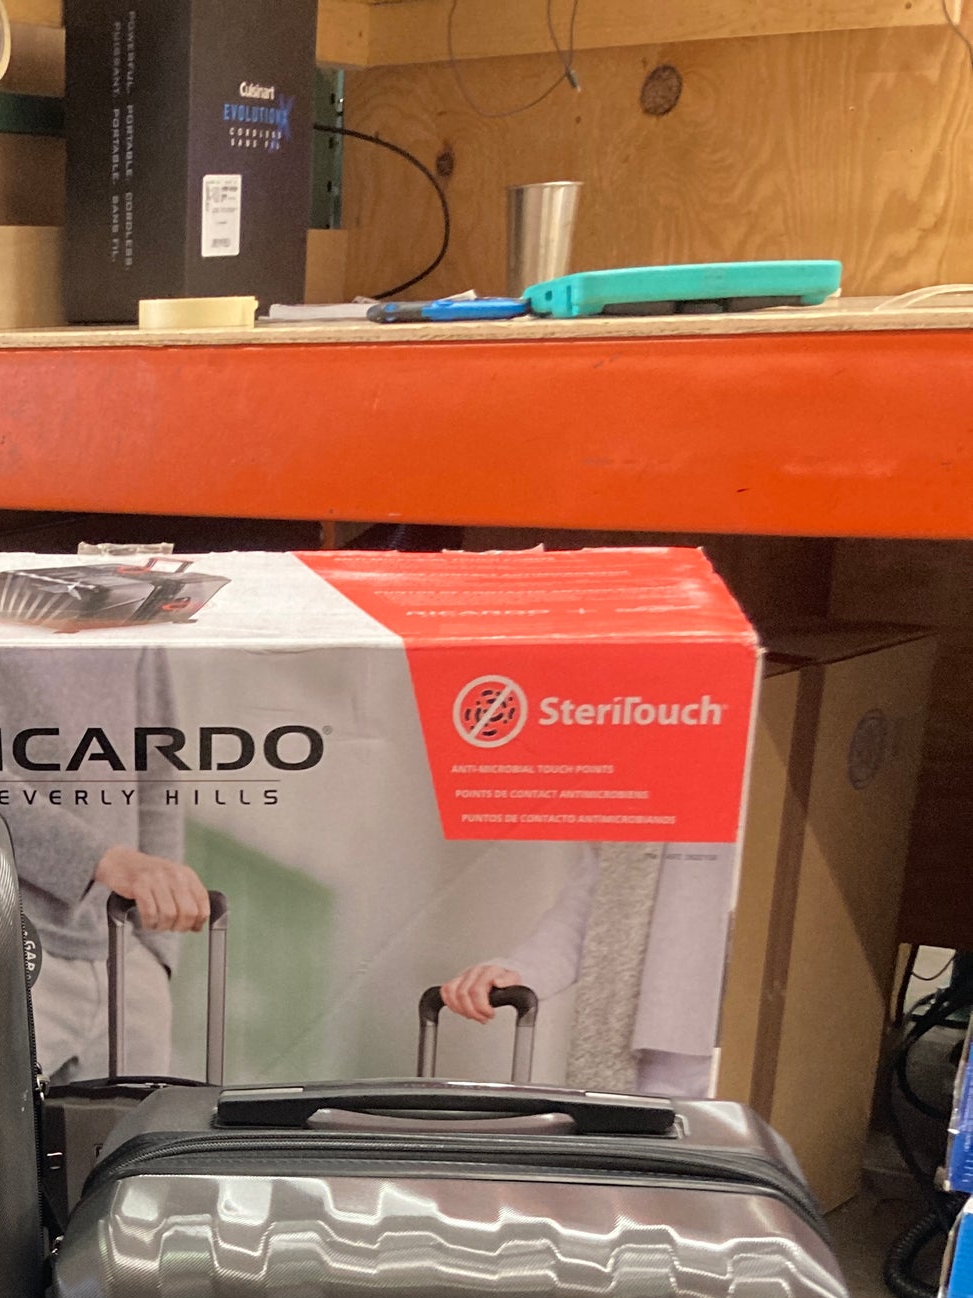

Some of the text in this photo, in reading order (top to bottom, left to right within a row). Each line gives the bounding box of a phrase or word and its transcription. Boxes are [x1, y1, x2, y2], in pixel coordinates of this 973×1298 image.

[239, 81, 275, 100] Cuisinart
[537, 765, 574, 774] TOUCH
[575, 765, 614, 775] POINTS
[165, 789, 279, 806] HILLS
[455, 789, 492, 799] POINTS
[509, 789, 558, 799] CONTACT
[461, 814, 502, 824] PUNTOS
[519, 814, 576, 824] CONTACTO
